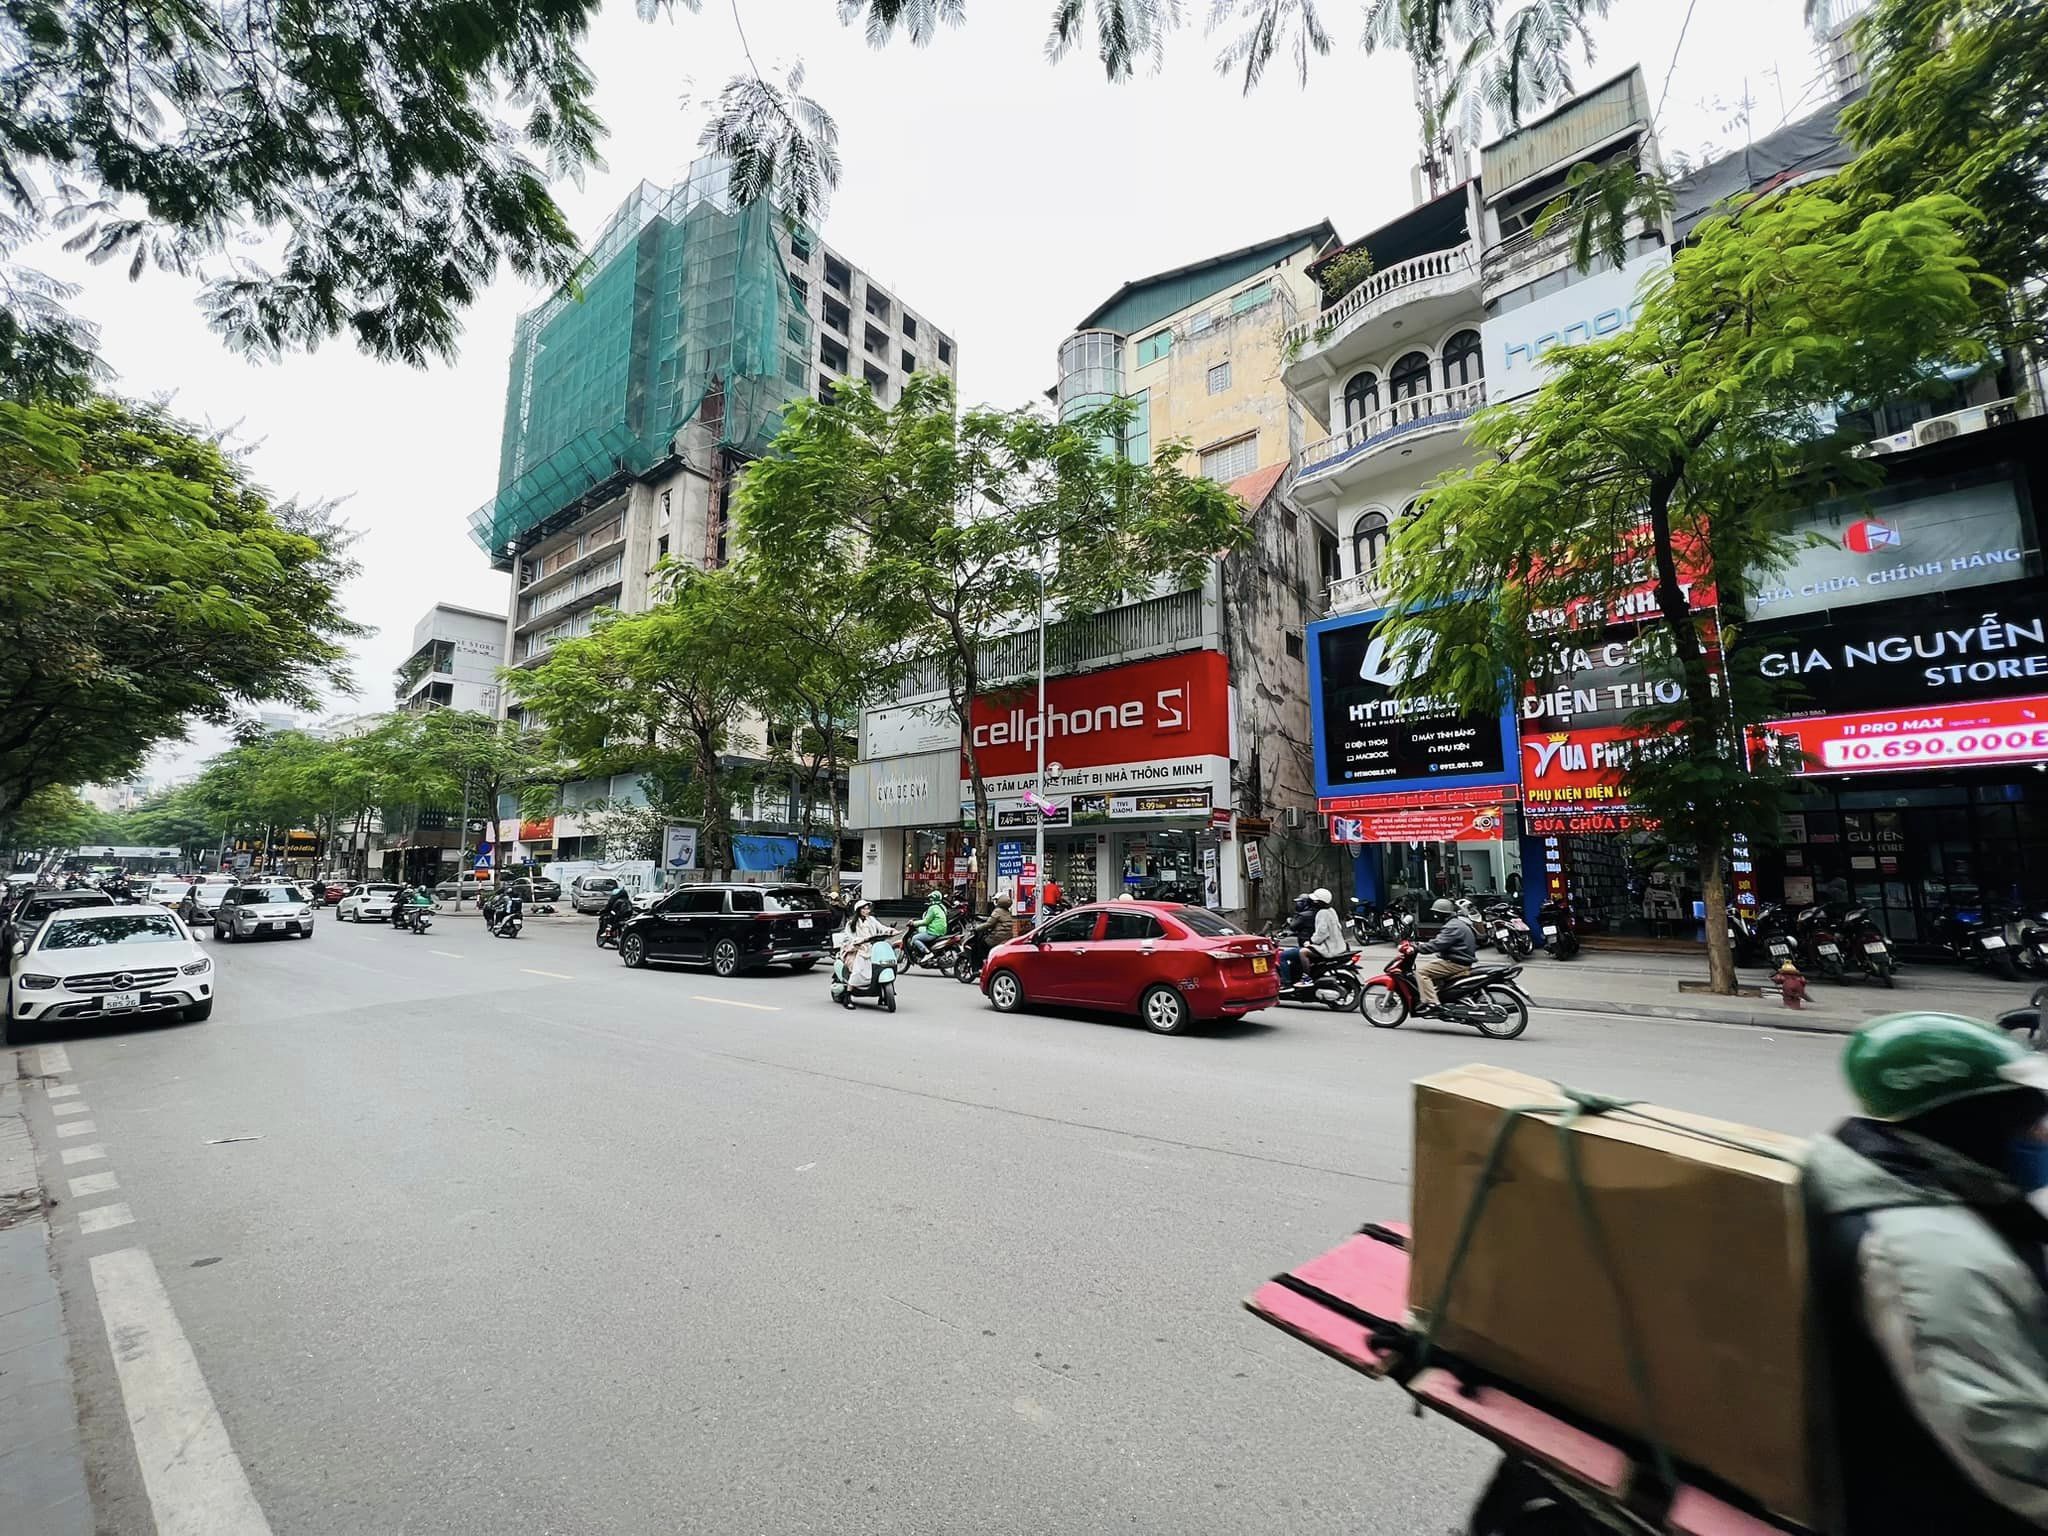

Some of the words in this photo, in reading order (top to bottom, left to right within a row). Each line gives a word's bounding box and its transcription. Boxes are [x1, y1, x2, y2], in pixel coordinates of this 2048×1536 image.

[1799, 575, 1860, 598] CHỮA
[1866, 562, 1942, 586] CHÍNH
[1616, 582, 1692, 618] NHT
[1759, 648, 1832, 678] GIA
[1844, 612, 2046, 668] NGUYỄN
[1924, 654, 2048, 687] STORE
[1522, 684, 1598, 723] ĐIỆN
[973, 700, 1144, 752] cellphone
[1418, 731, 1435, 741] MÁY
[1843, 725, 1856, 736] 11
[1860, 720, 1898, 735] PRO
[1902, 717, 1945, 732] MAX
[1351, 739, 1367, 749] ĐIỆN
[1368, 738, 1388, 748] THOẠI
[1355, 751, 1389, 761] MACBOOK
[997, 779, 1015, 792] TÂM
[1061, 769, 1088, 786] THIẾT
[1092, 773, 1103, 786] BỊ
[1106, 767, 1128, 782] NHÀ
[1130, 765, 1168, 781] THÔNG
[1172, 763, 1203, 777] MINH
[1140, 802, 1156, 810] 3.99
[1528, 789, 1551, 805] PHỤ
[1554, 785, 1582, 803] KIỆN
[1585, 783, 1614, 802] ĐIỆN
[1534, 815, 1565, 831] SỬA
[1569, 813, 1615, 830] CHỮA
